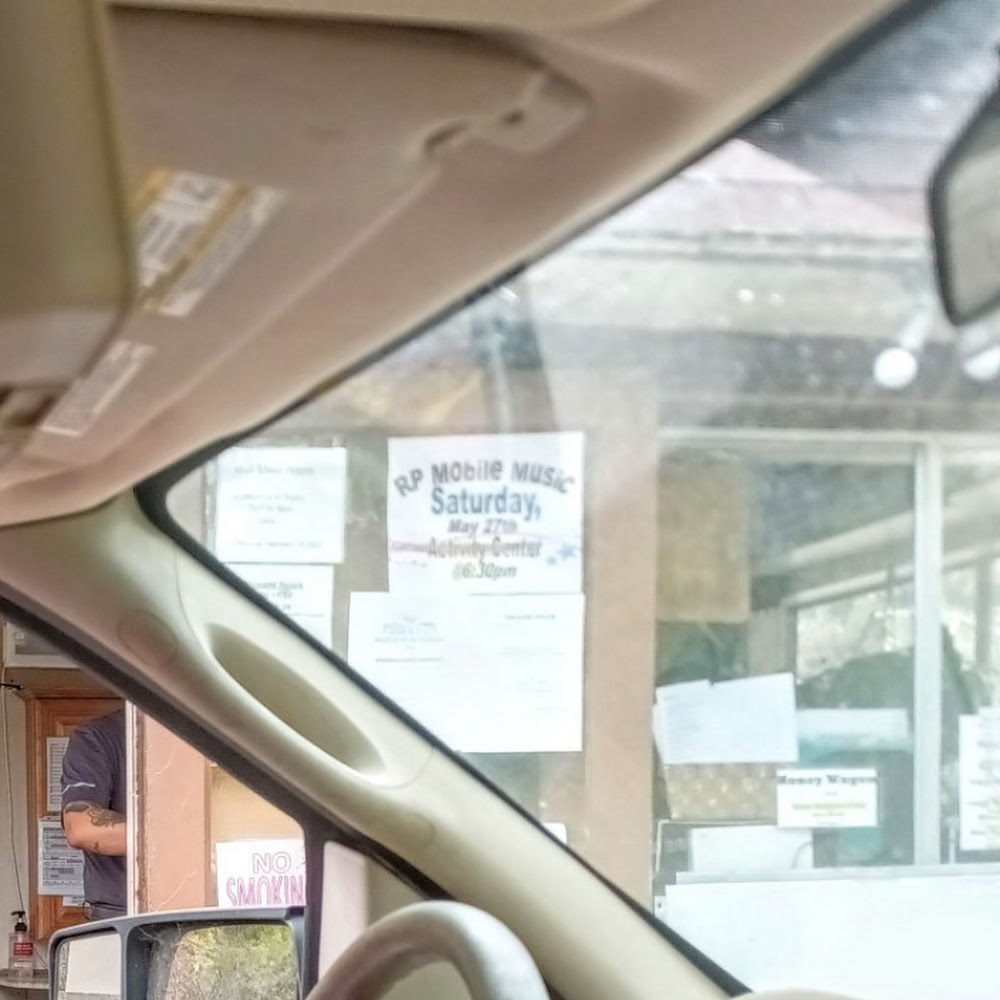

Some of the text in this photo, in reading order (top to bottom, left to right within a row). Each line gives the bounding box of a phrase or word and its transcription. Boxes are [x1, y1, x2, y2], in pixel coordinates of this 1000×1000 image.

[394, 468, 423, 497] RP
[431, 460, 503, 484] Mobile
[431, 486, 541, 521] Saturday,
[447, 518, 517, 537] May 27th
[428, 537, 542, 561] Activity Center
[252, 851, 292, 874] NO
